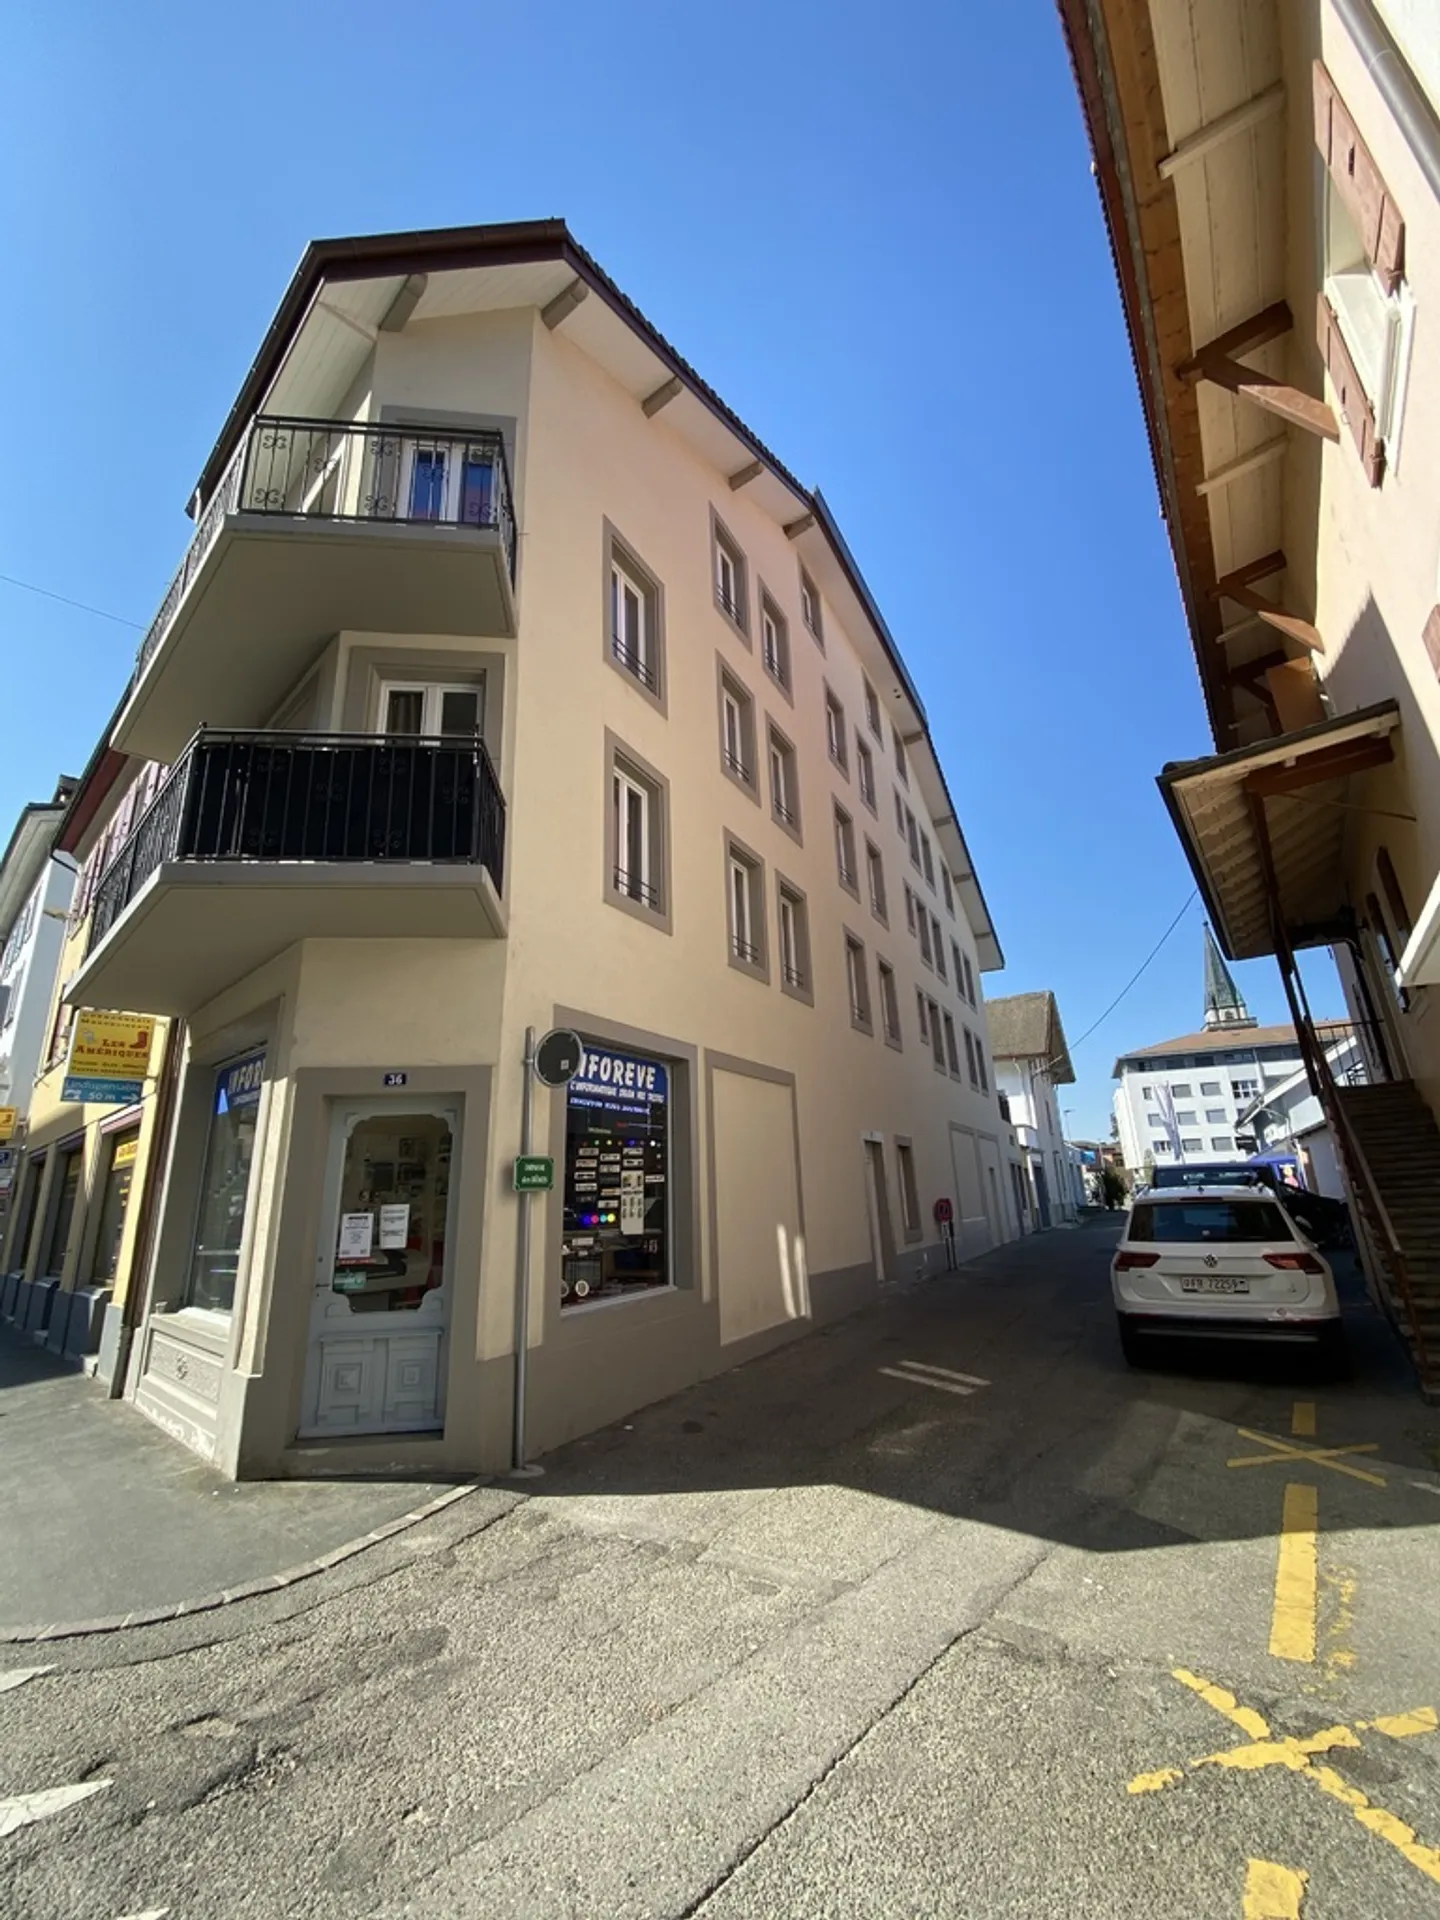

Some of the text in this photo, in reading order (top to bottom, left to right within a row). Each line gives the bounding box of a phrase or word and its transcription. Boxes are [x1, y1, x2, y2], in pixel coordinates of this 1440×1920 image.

[388, 1074, 403, 1085] 36
[88, 1091, 117, 1100] 50 m
